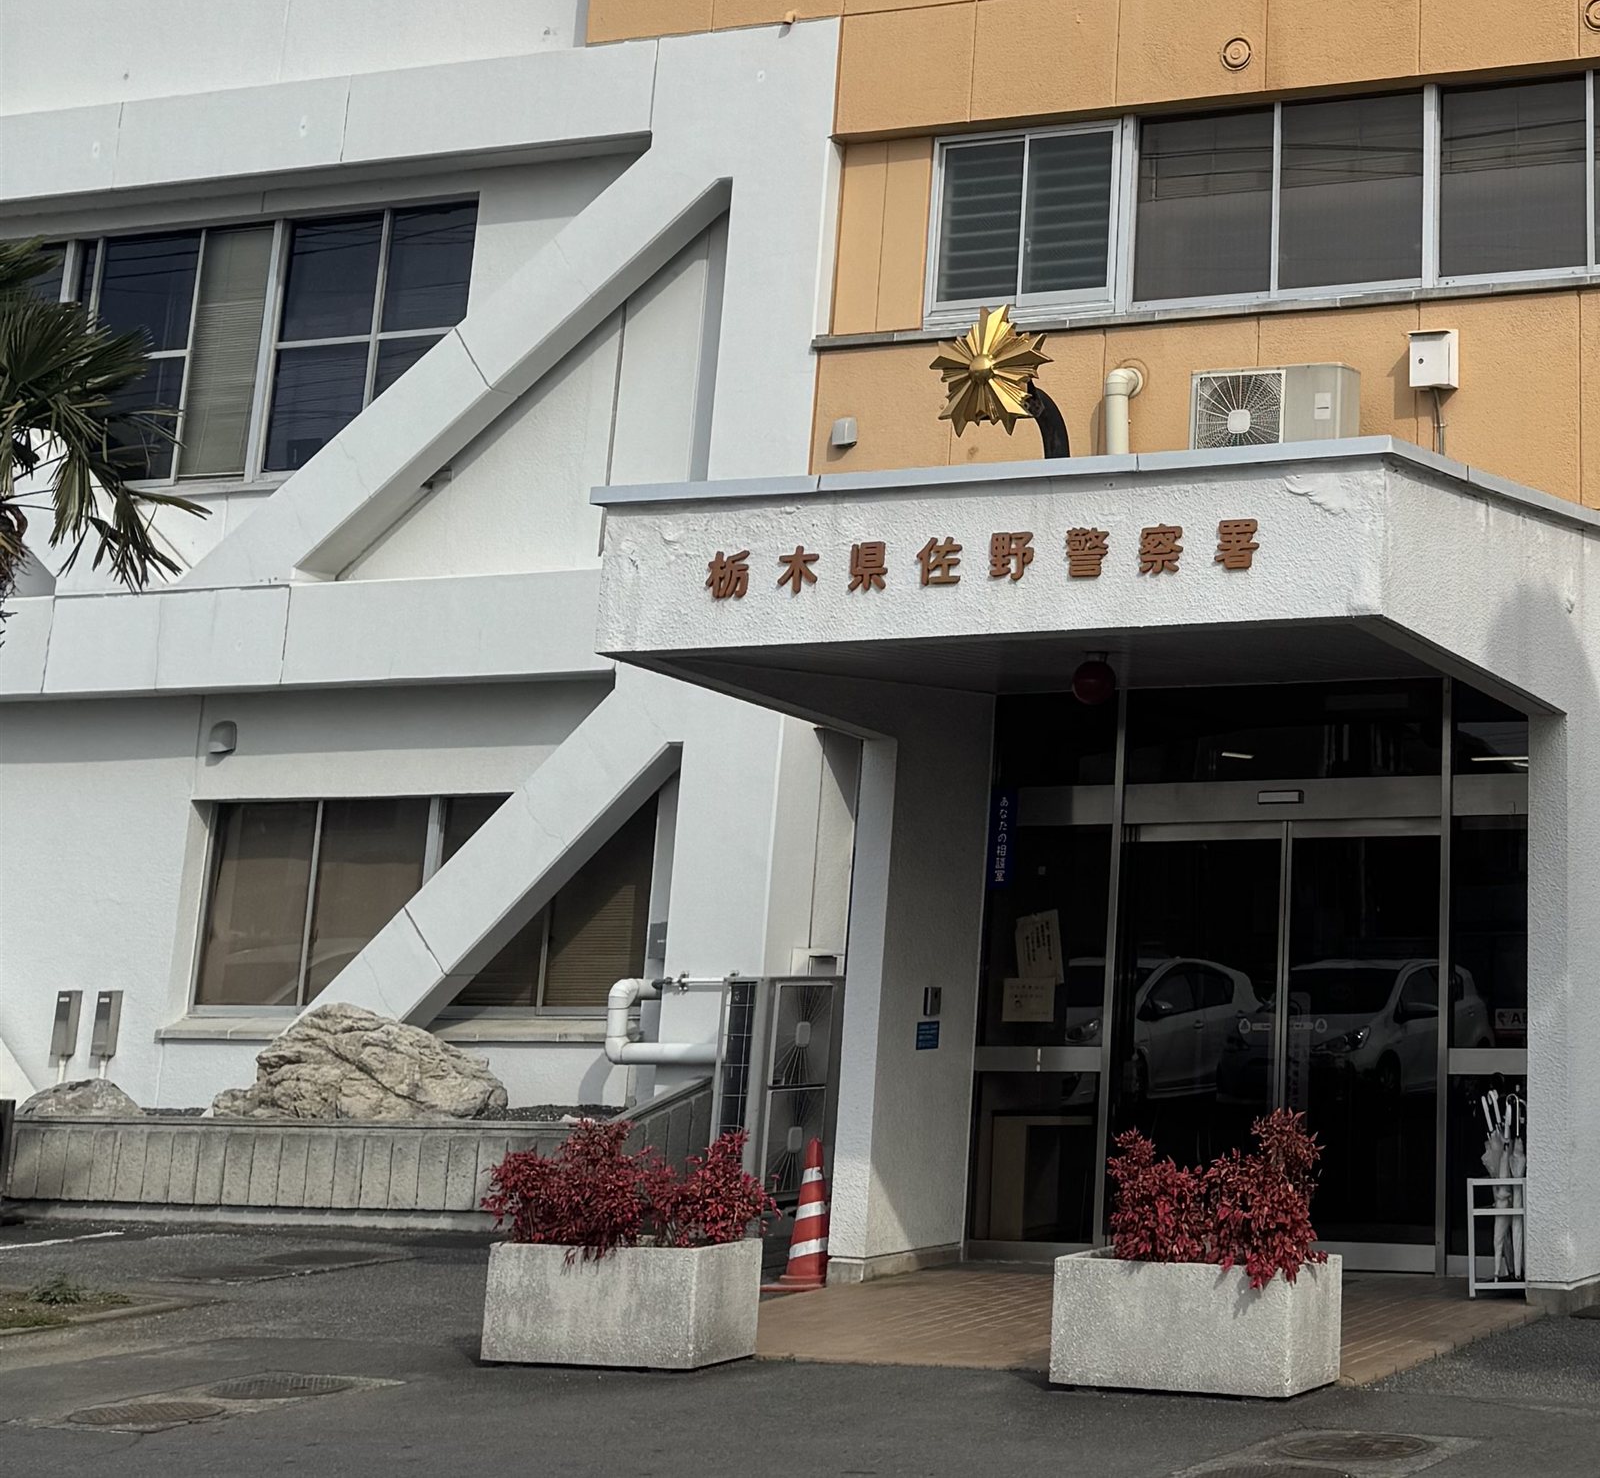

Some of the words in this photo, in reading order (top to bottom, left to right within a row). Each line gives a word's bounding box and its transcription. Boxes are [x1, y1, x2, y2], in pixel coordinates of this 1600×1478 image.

[706, 519, 1260, 598] 栃木県佐野警察署
